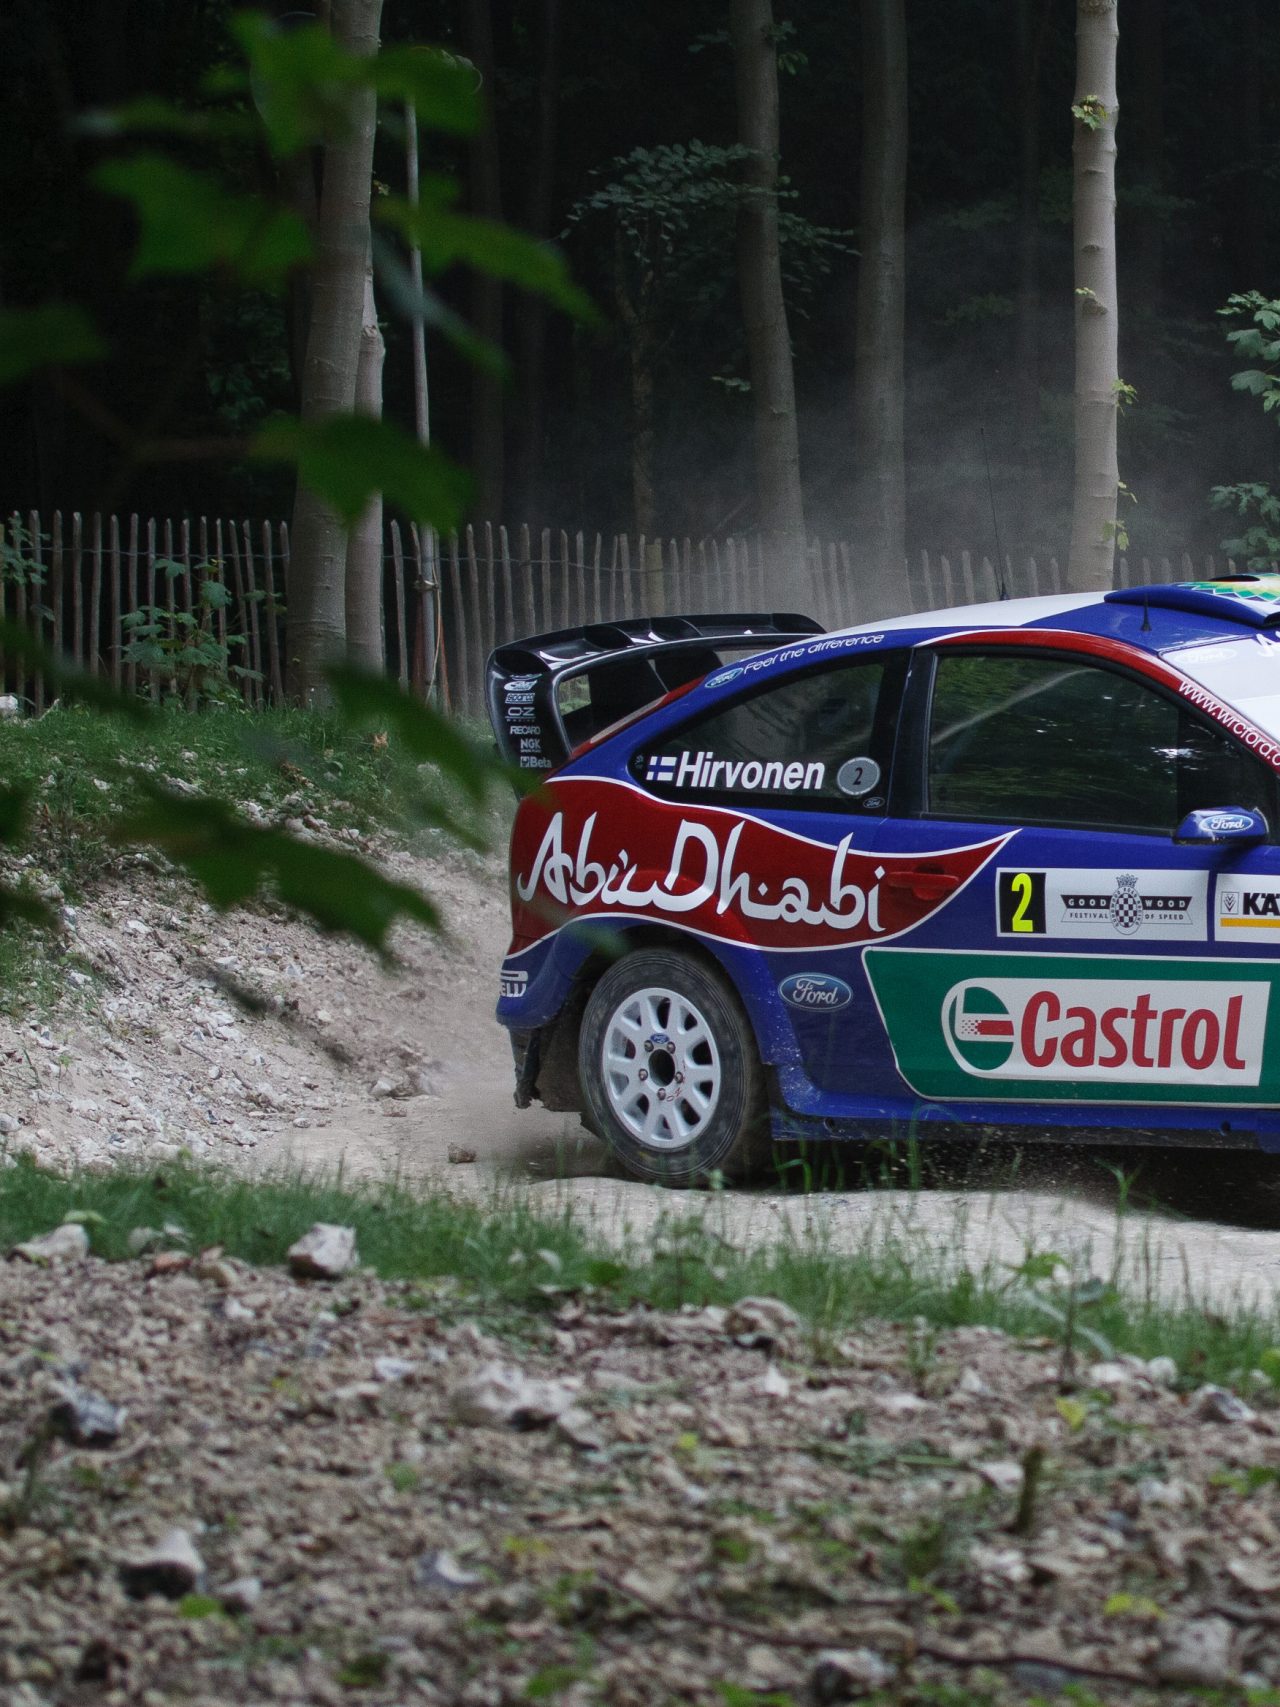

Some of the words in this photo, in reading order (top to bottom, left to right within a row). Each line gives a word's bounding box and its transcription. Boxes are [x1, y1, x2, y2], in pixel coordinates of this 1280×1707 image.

[743, 654, 777, 675] Feel
[780, 648, 805, 662] the
[807, 634, 885, 654] difference
[510, 725, 541, 735] RECARO
[520, 738, 541, 749] NGK
[530, 756, 552, 768] Beta
[676, 751, 825, 789] Hirvonen
[852, 767, 864, 786] 2
[517, 812, 662, 906] Abu
[664, 818, 887, 932] Dhabi
[1012, 873, 1033, 932] 2
[1068, 898, 1107, 907] GOOD
[1144, 899, 1186, 908] WOOD
[1069, 912, 1109, 920] FESTIVAL
[792, 978, 839, 1005] Ford
[1020, 990, 1247, 1070] Castrol
